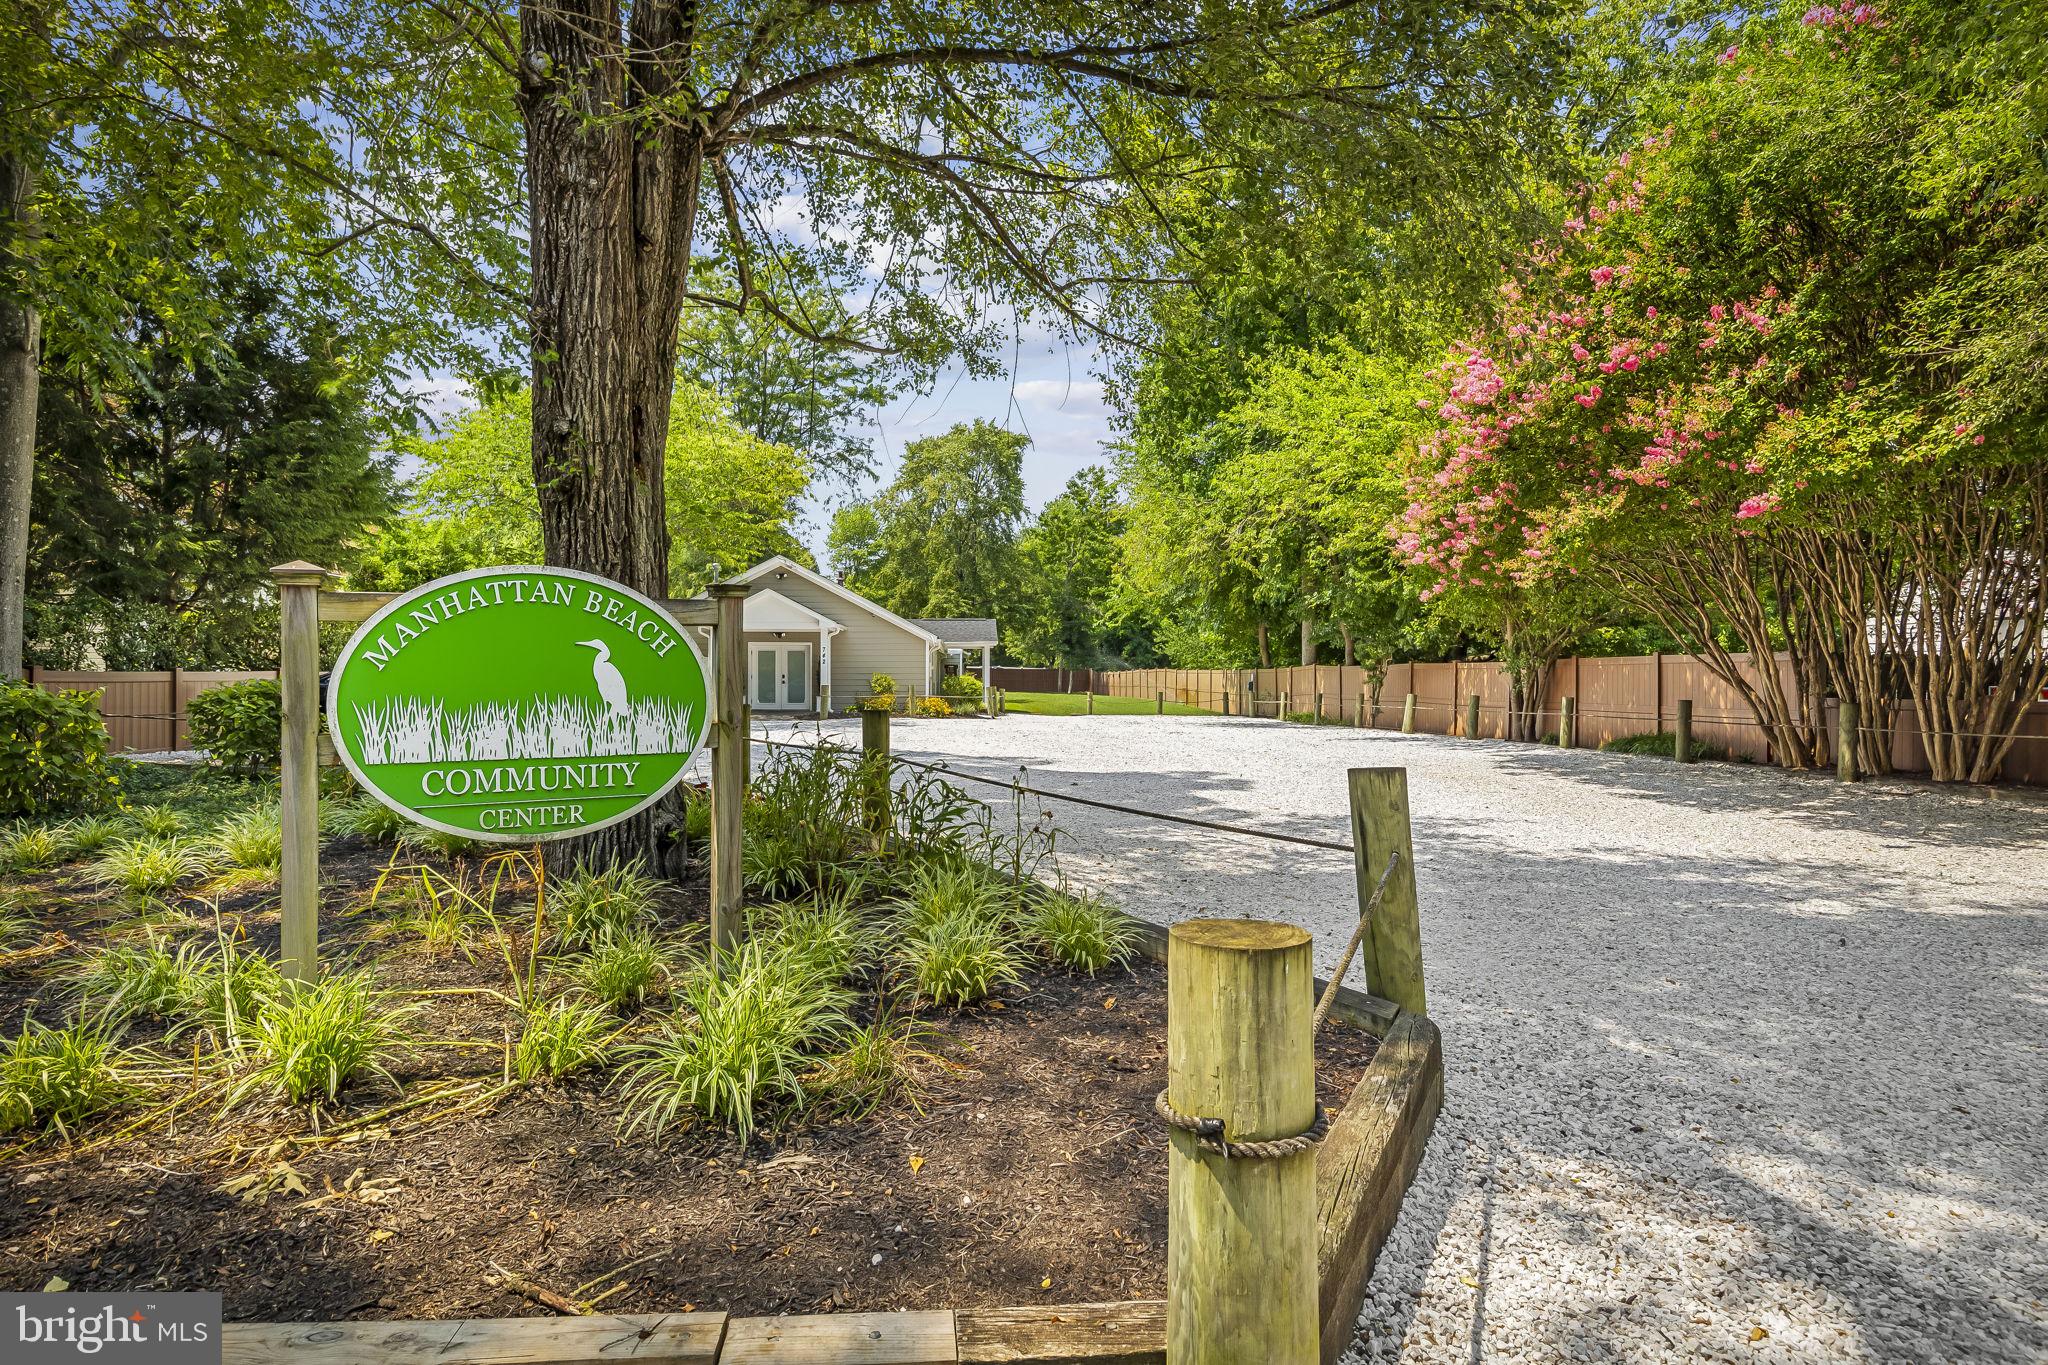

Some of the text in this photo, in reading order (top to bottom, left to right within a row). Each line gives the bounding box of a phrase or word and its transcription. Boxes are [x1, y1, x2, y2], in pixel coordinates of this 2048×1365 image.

[361, 580, 677, 671] MANHATTAN BEACH
[421, 762, 640, 796] COMMUNITY
[479, 804, 586, 831] CENTER
